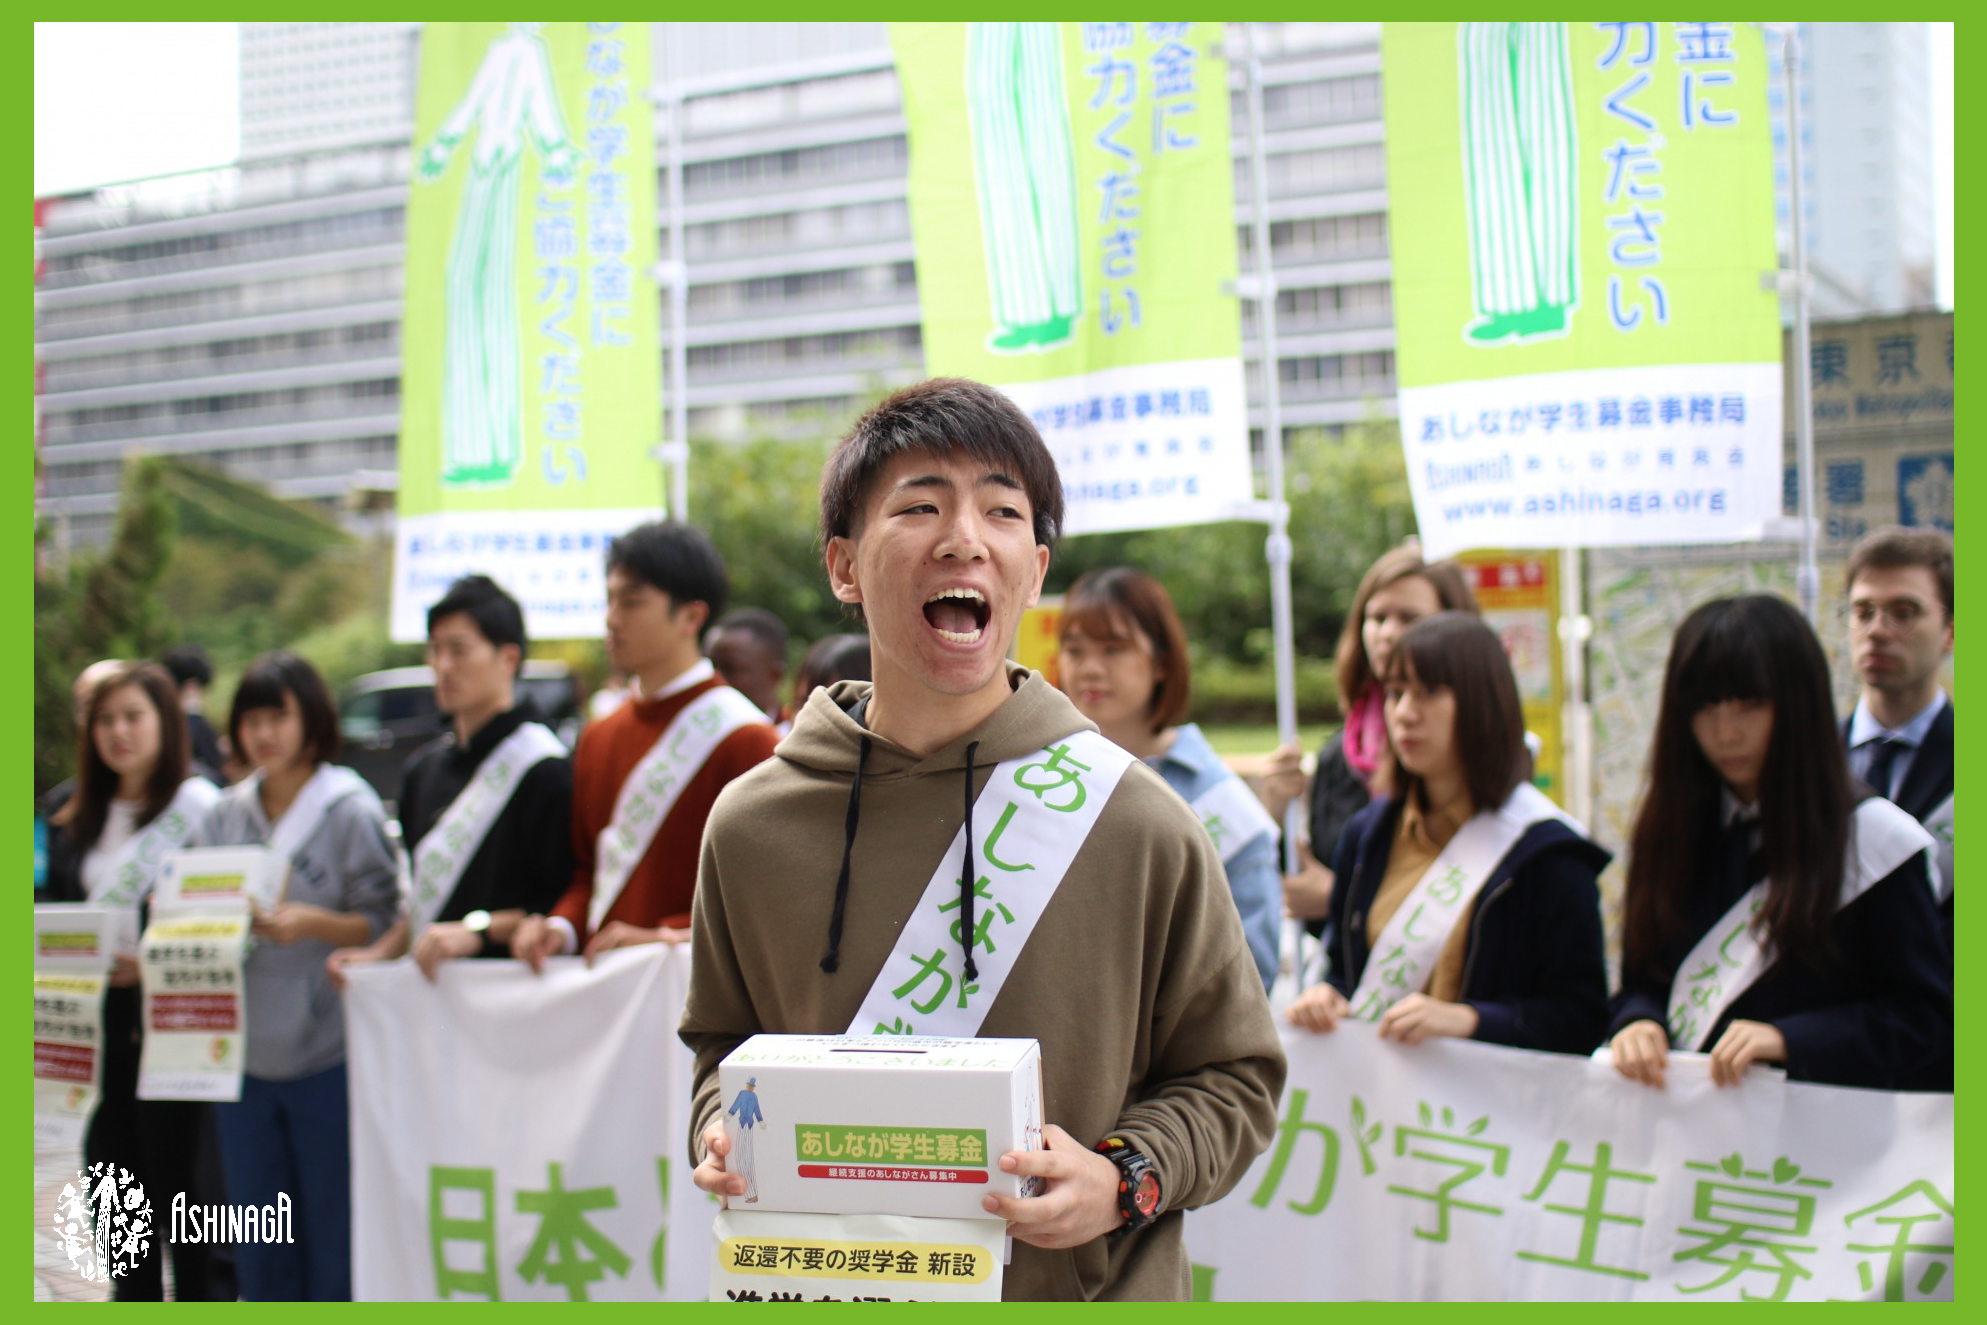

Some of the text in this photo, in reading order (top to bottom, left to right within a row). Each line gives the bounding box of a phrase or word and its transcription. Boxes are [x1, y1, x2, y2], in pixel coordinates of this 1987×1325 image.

[1811, 333, 1954, 388] 東京
[1420, 393, 1747, 443] あしなが学生募金事務局
[1443, 487, 1727, 521] www.ashinaga.org
[801, 1131, 984, 1163] あしなが学生募金
[828, 1167, 958, 1182] 継続支援のあしながさん募集中
[733, 1243, 977, 1277] 返還不要の奨学金 新設
